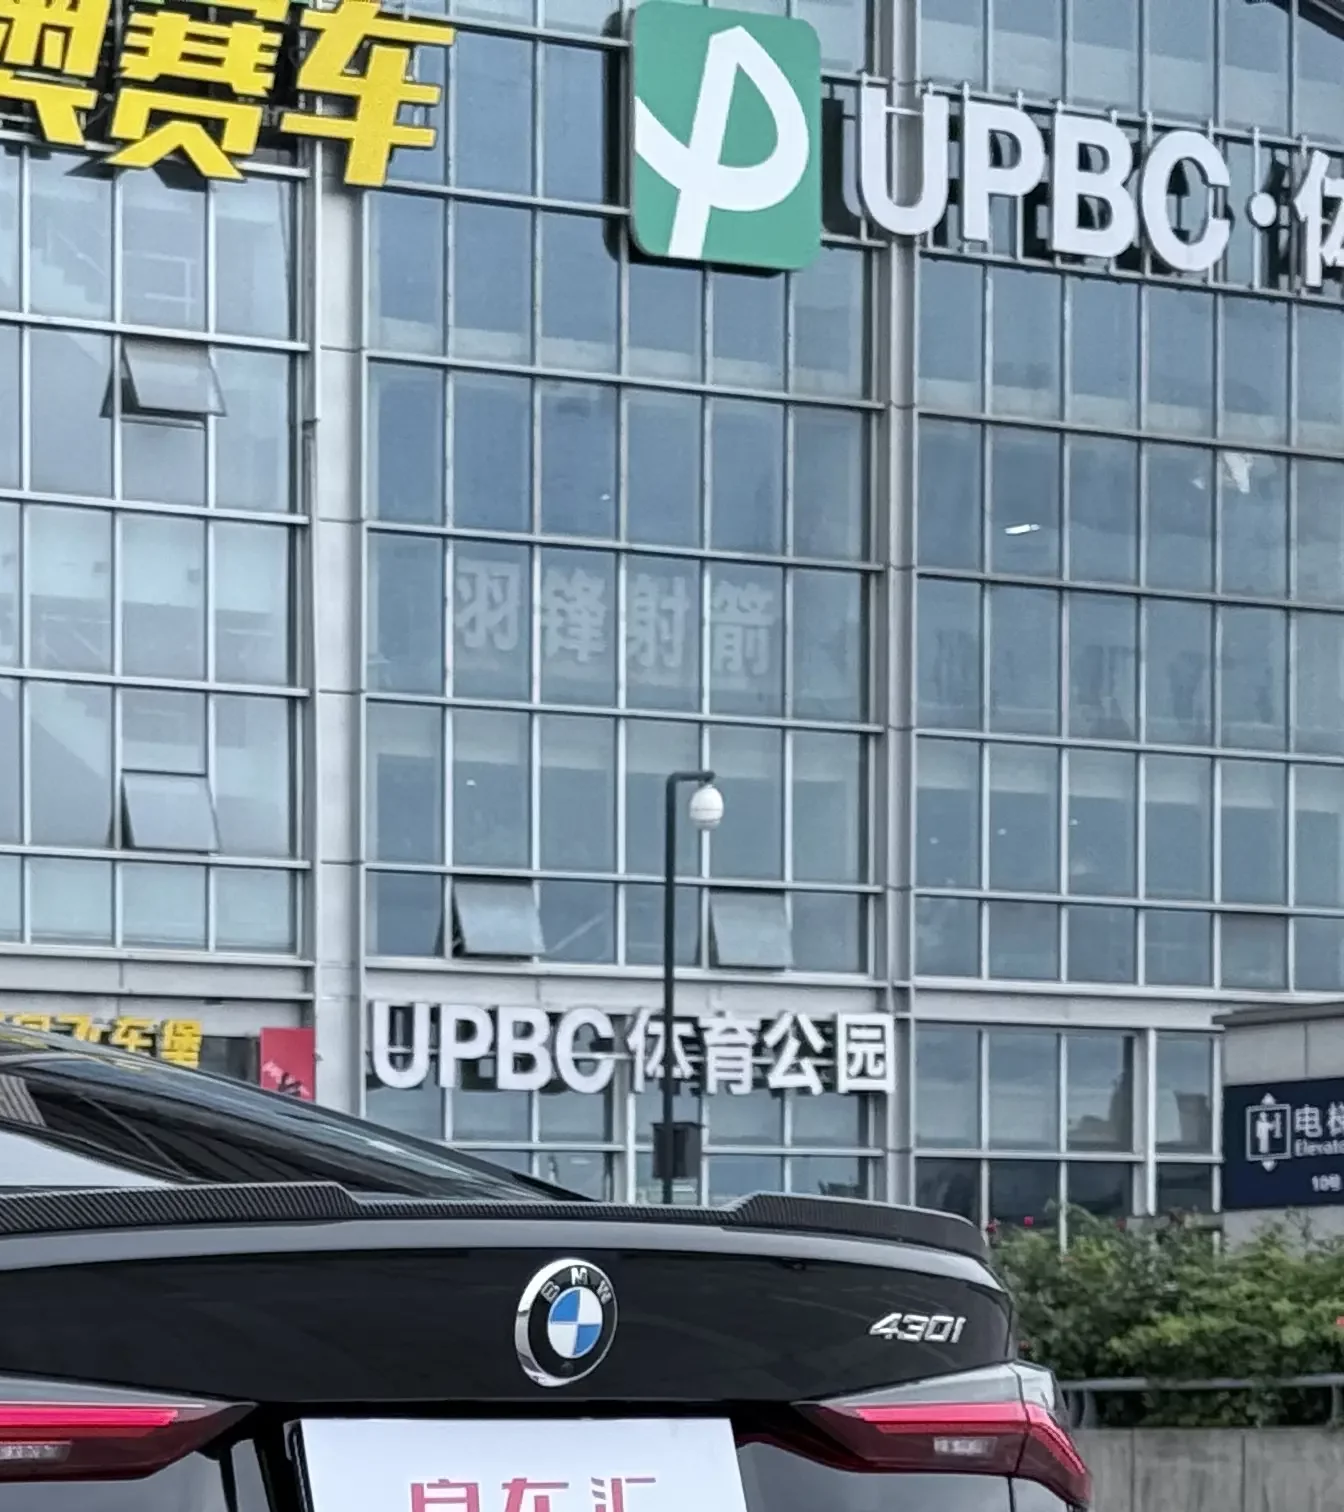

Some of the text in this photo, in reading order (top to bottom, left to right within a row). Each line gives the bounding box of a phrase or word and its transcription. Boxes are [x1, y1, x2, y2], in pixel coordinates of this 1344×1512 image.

[455, 558, 778, 676] 羽锋射箭
[540, 1267, 612, 1304] BMW
